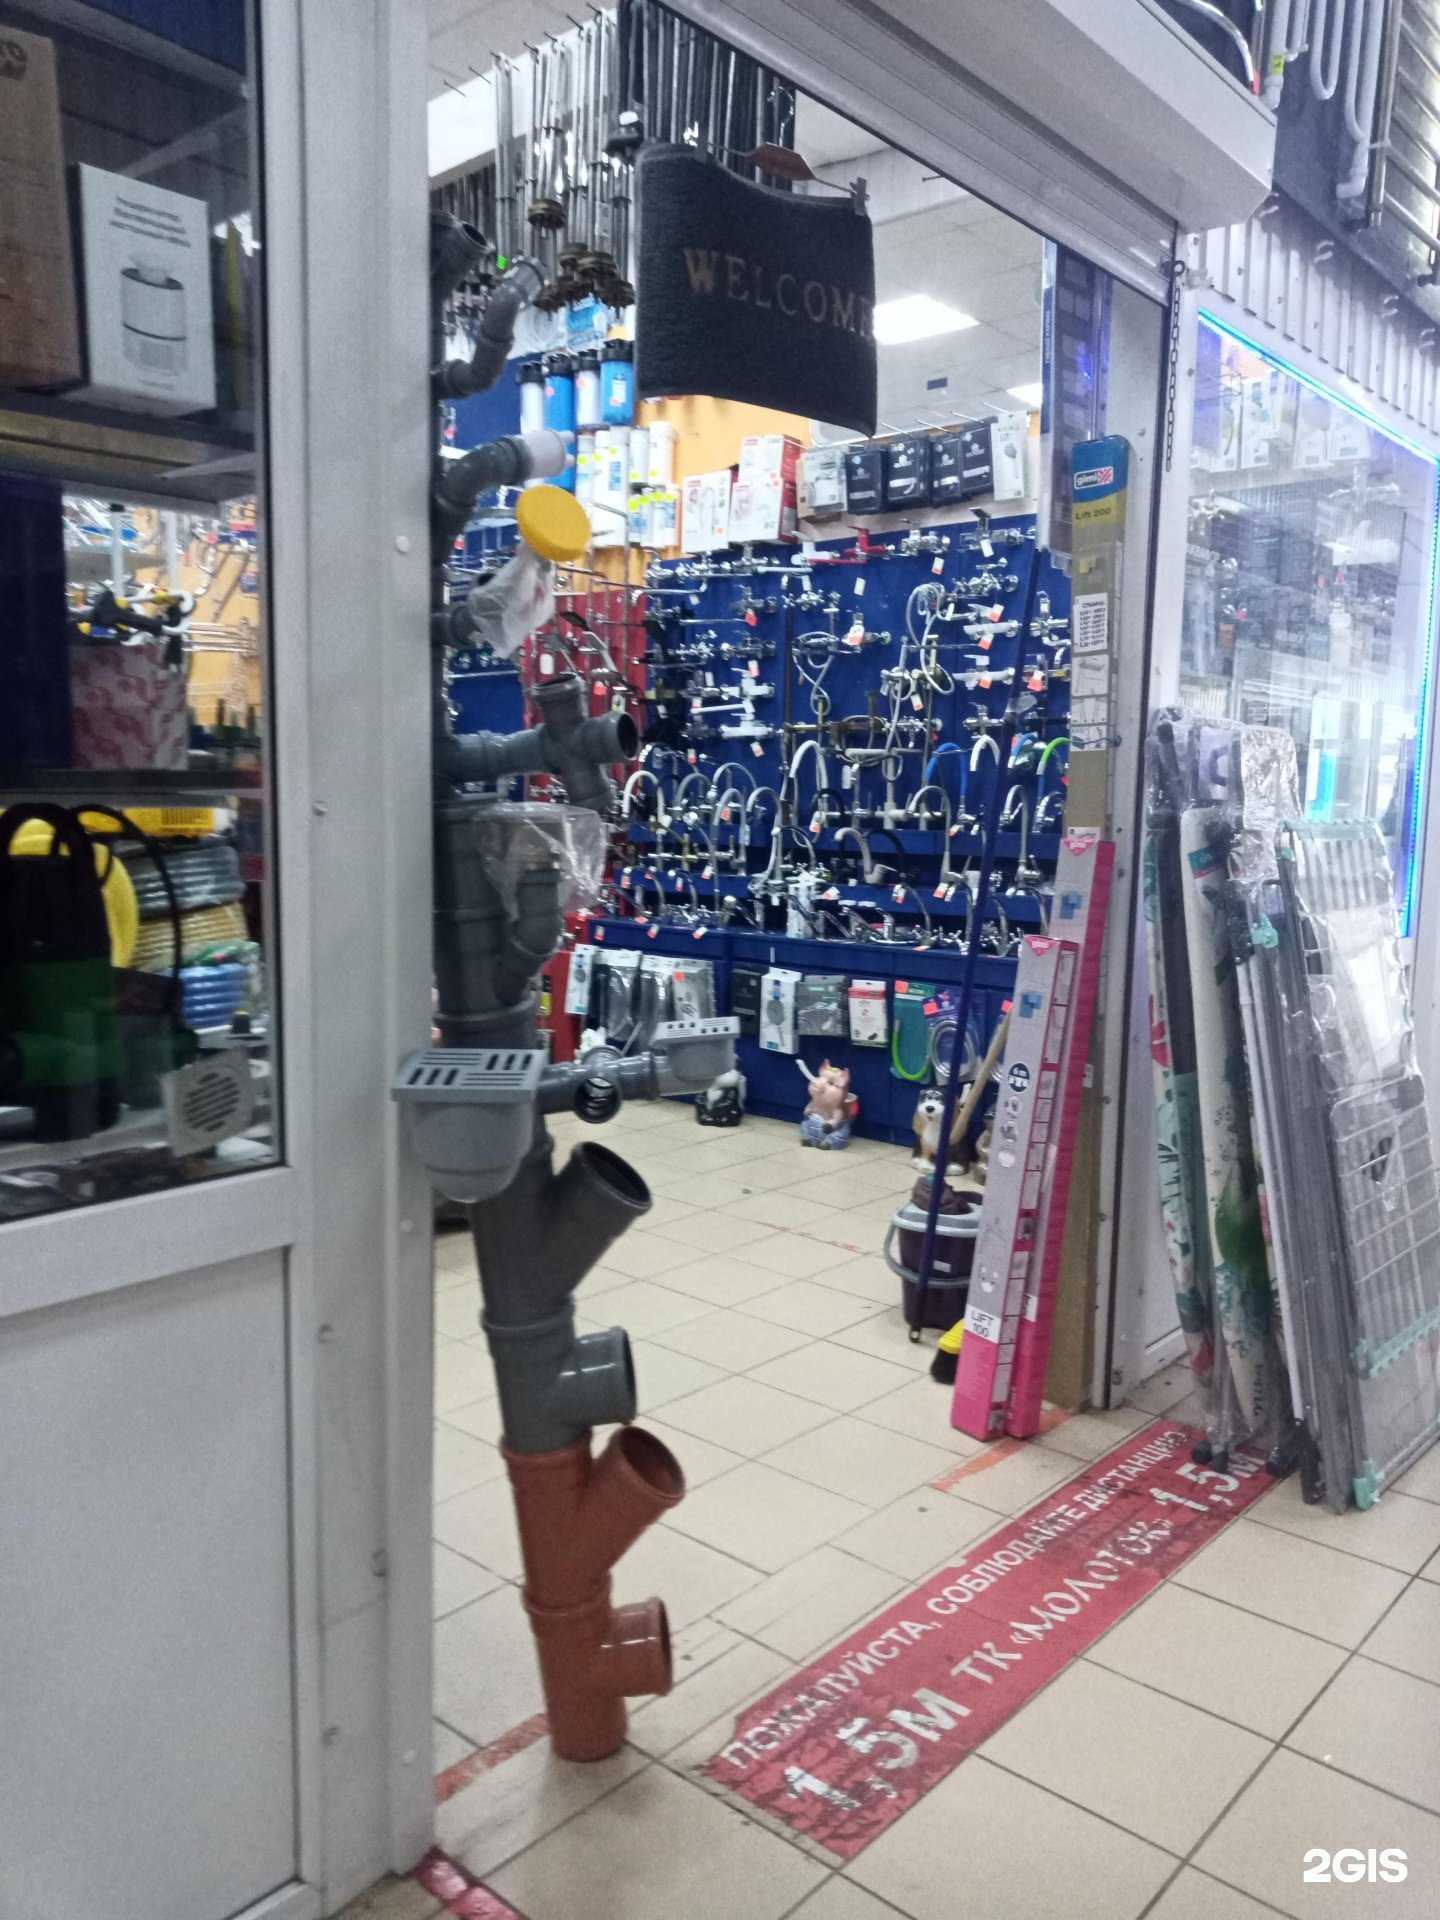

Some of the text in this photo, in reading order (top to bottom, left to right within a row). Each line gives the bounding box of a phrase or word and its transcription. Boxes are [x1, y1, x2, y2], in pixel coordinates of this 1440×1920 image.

[683, 247, 875, 340] WELCOME
[971, 1310, 994, 1325] LIFT
[973, 1322, 989, 1337] 100
[926, 1504, 1088, 1616] СОБЛЮДАЙТЕ
[1074, 1430, 1189, 1511] ДИСТАНЦИЮ
[951, 1636, 1026, 1686] ТК
